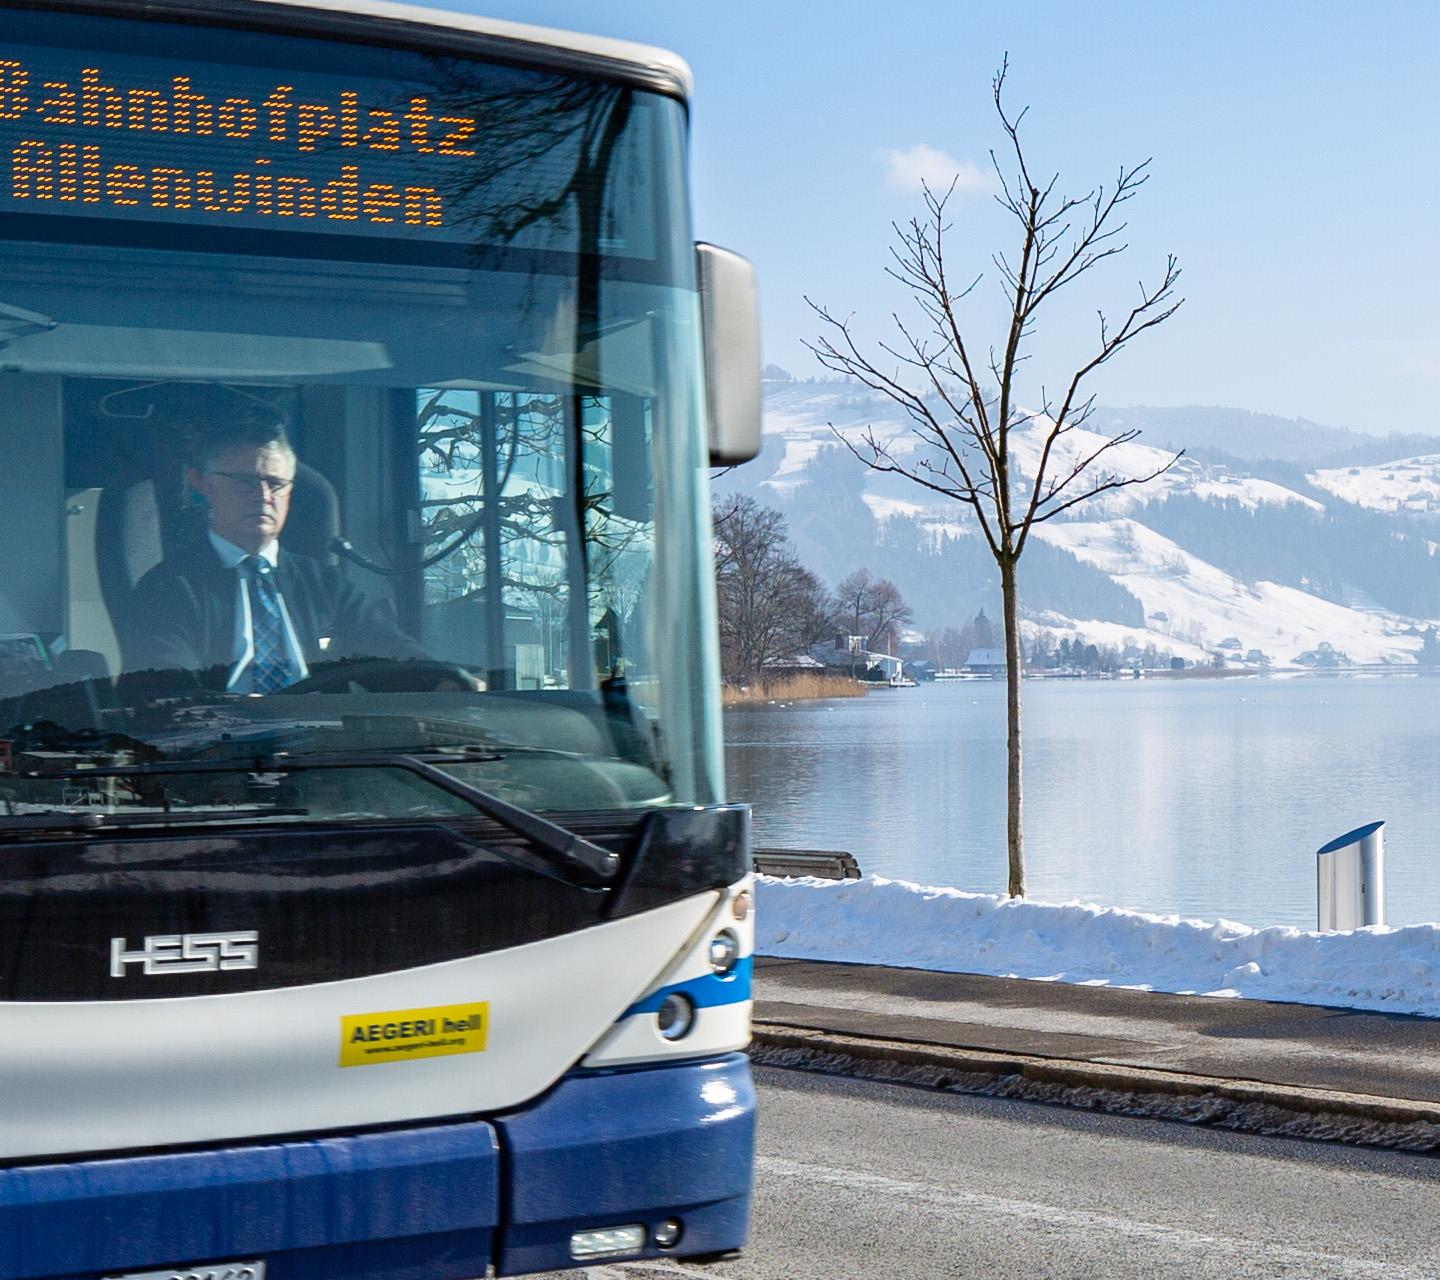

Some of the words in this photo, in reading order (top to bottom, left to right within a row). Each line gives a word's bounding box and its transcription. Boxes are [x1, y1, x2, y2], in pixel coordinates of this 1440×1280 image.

[12, 140, 443, 227] Allenwinden
[110, 930, 259, 978] HESS
[350, 1019, 436, 1044] AEGERI
[441, 1013, 482, 1034] hell
